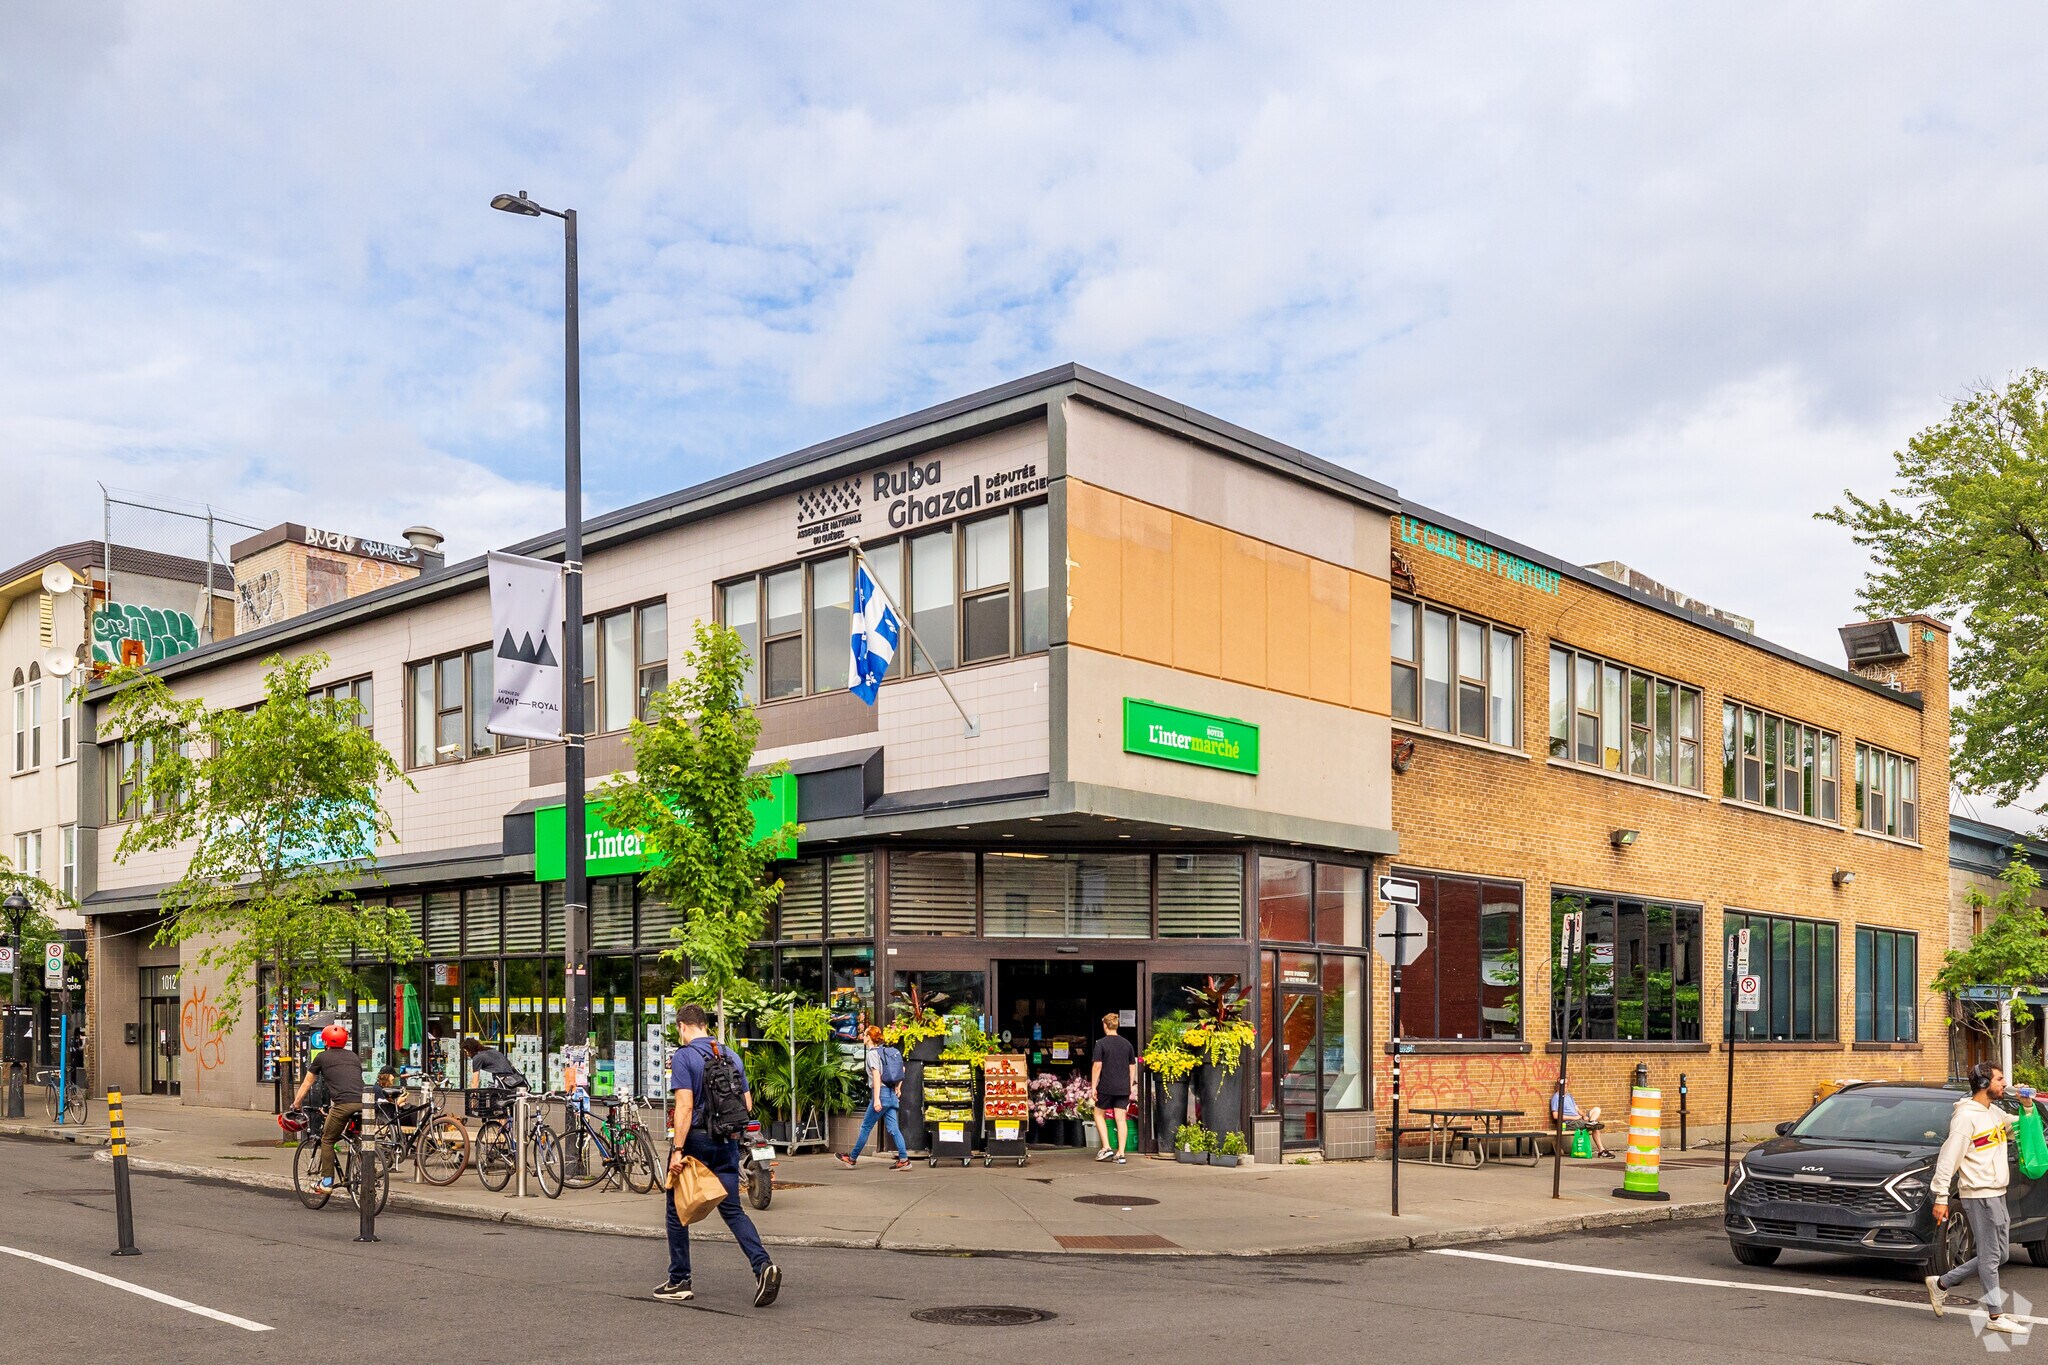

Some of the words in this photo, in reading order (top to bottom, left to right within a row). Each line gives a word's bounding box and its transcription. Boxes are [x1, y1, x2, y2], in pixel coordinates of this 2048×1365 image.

[873, 460, 941, 501] Ruba
[986, 464, 1036, 489] DÉPUTÉE
[888, 475, 981, 528] Ghazal
[985, 490, 1001, 504] DE
[1004, 476, 1049, 499] MERCIE
[797, 522, 829, 539] ASSEMBLÉE
[830, 514, 862, 530] NATIONALE
[813, 536, 821, 545] DU
[822, 530, 845, 543] QUÉBEC
[1401, 515, 1419, 545] LE
[1423, 525, 1462, 562] CIEL
[1465, 538, 1494, 573] EST
[1497, 551, 1561, 596] PARTOUT
[161, 974, 177, 990] 1012
